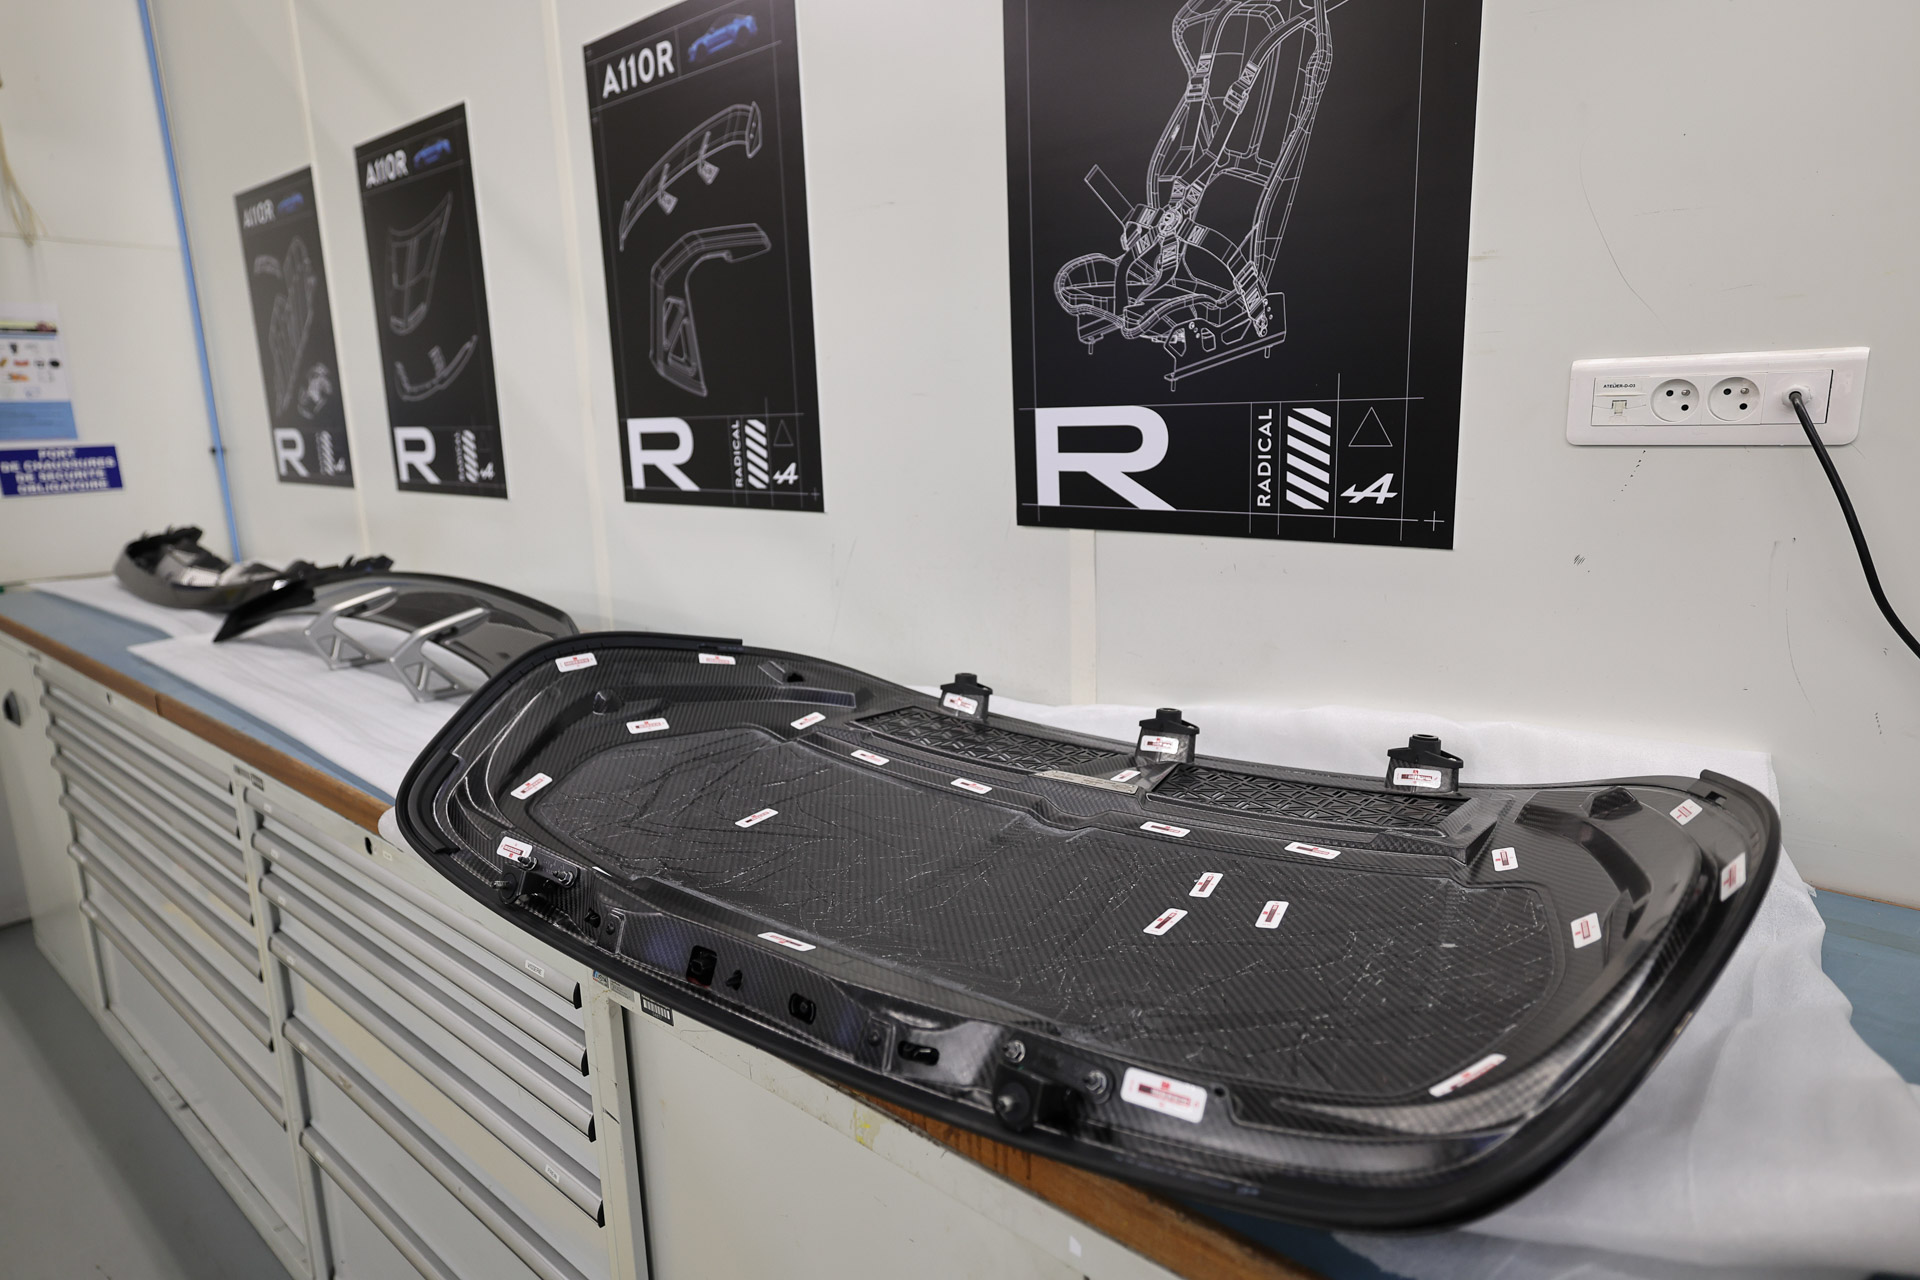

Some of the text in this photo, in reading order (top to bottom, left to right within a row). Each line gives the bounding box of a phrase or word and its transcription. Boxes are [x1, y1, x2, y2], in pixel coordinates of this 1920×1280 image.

[602, 40, 675, 99] A110R
[365, 150, 408, 188] A110R
[243, 198, 276, 229] A110R
[274, 427, 310, 477] R
[393, 426, 441, 484] R
[627, 416, 700, 491] R
[731, 419, 744, 488] RADICAL
[1035, 405, 1177, 511] R
[1257, 408, 1273, 507] RADICAL
